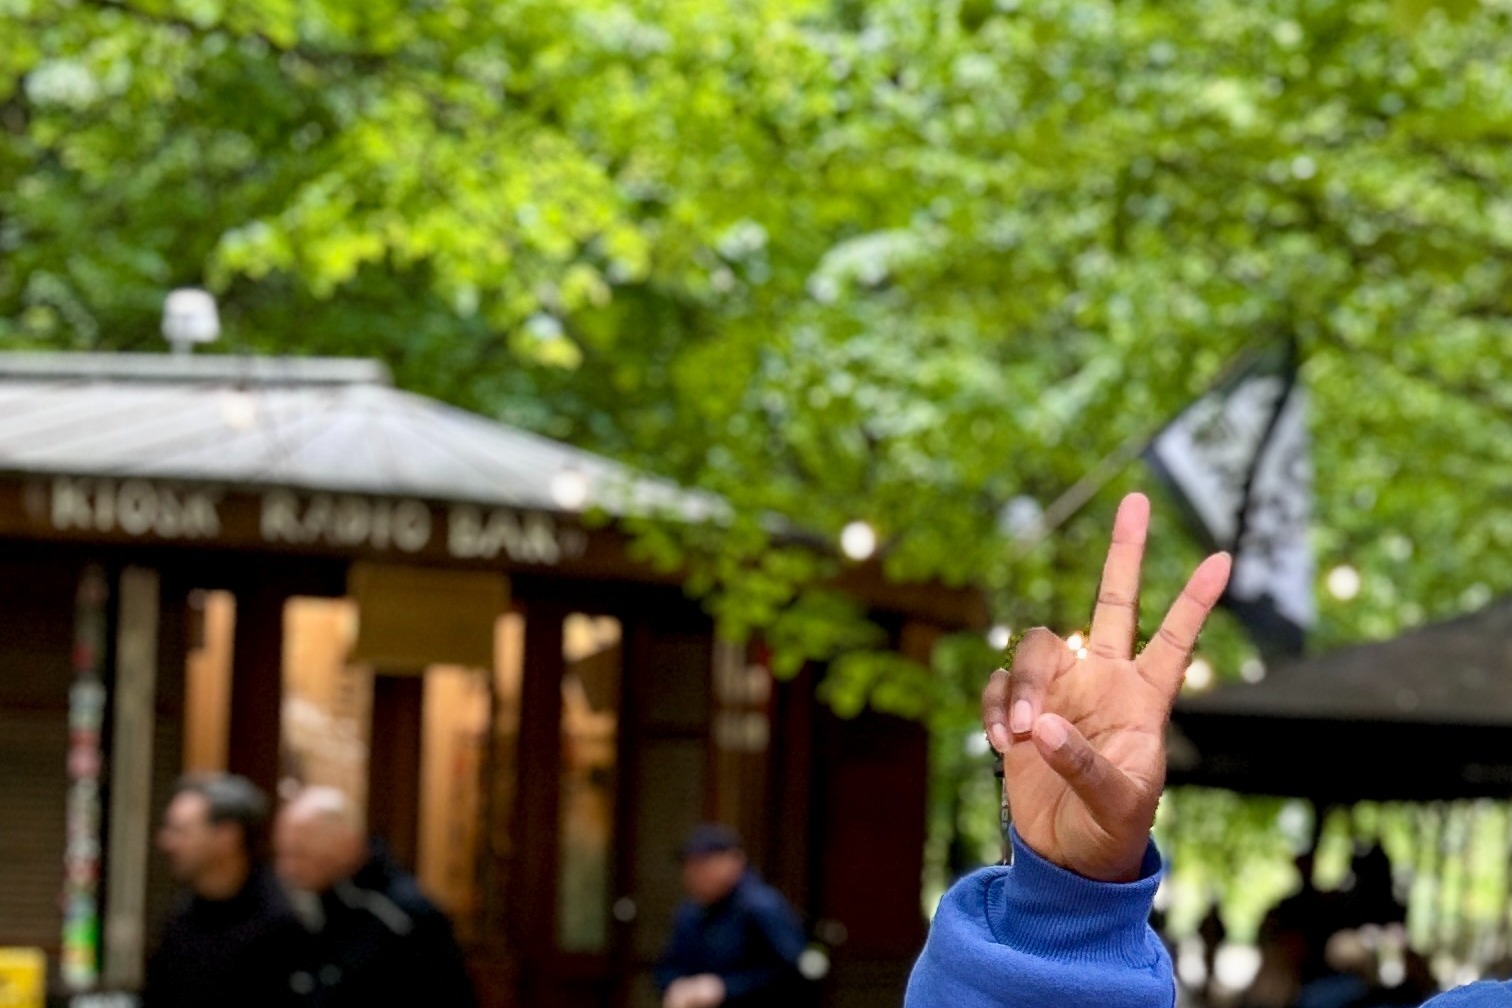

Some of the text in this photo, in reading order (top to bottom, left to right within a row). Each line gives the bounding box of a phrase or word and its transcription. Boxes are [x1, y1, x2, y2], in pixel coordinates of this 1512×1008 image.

[52, 479, 558, 564] KIOSK RADIO BAR
